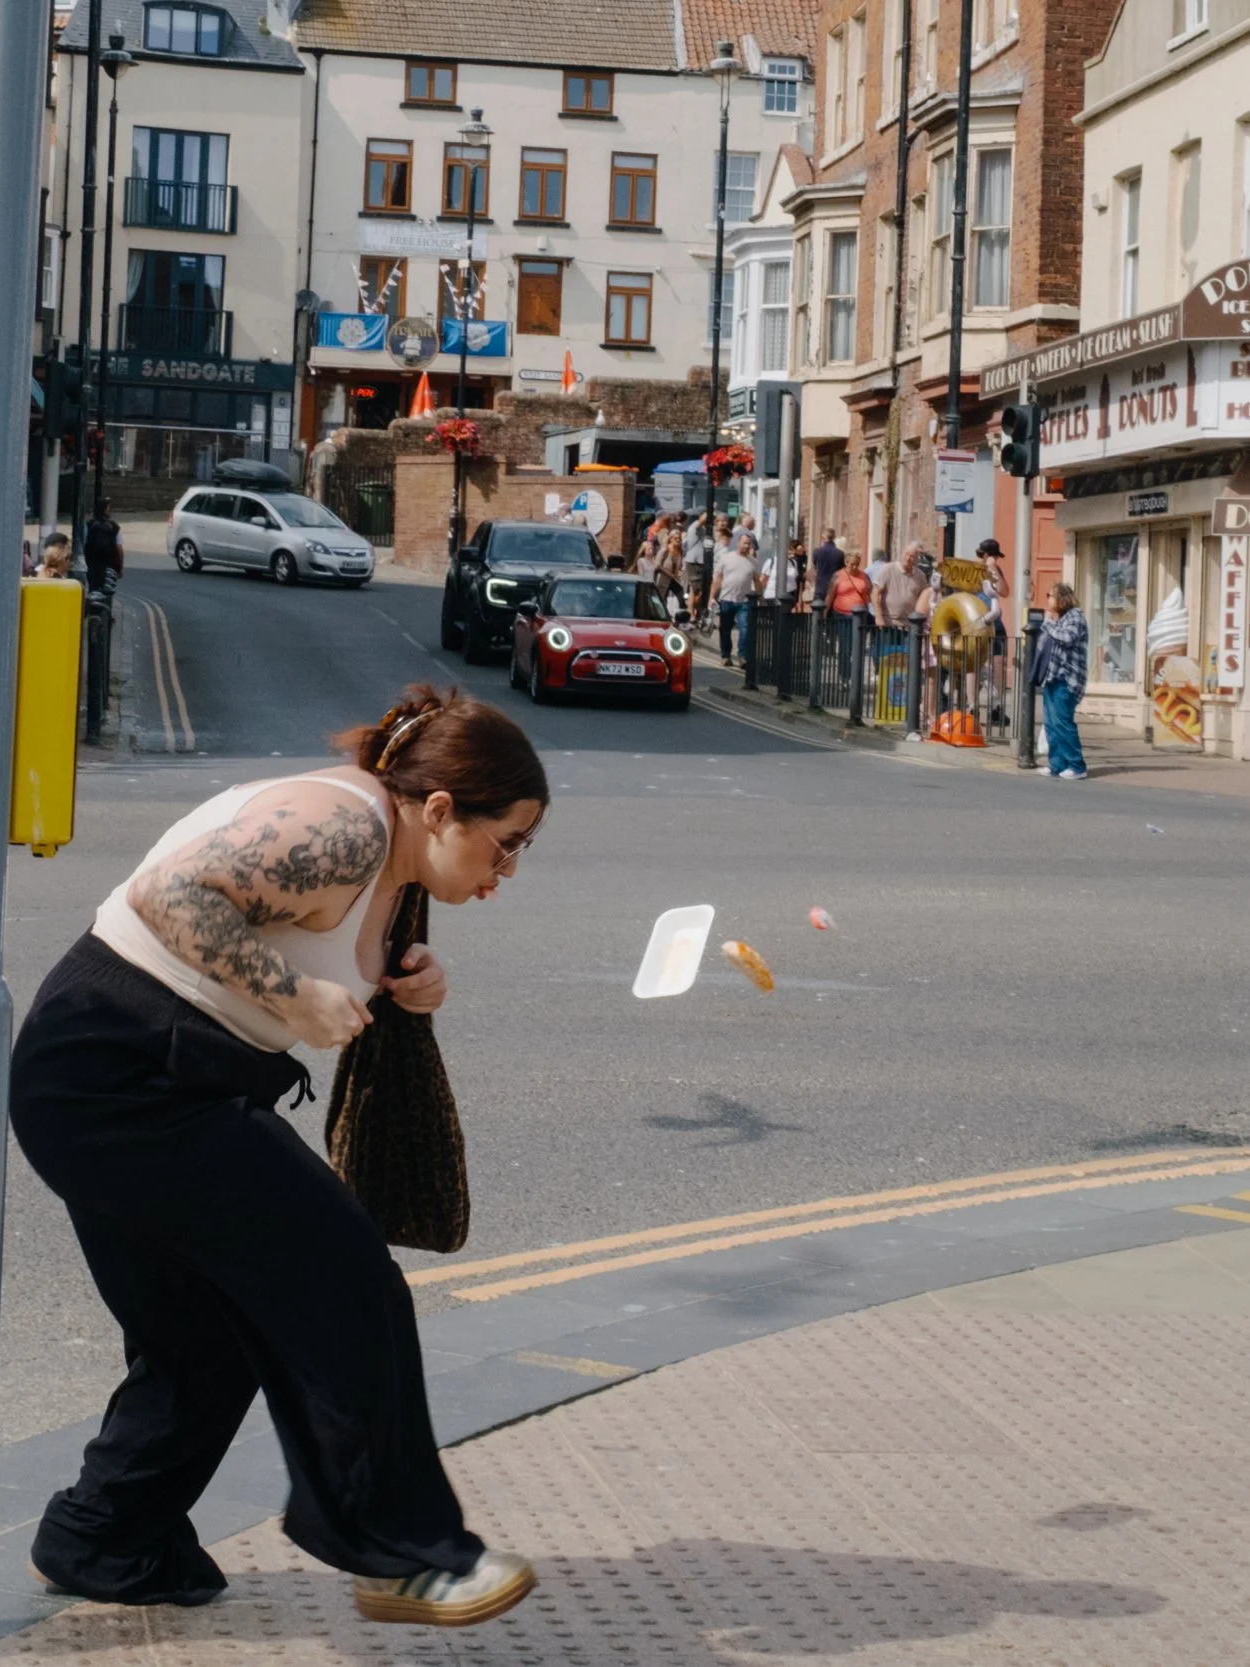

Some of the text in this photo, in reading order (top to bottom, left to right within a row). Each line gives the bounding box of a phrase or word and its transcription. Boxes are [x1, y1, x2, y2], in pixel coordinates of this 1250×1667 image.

[141, 358, 256, 384] SANDGATE
[1036, 344, 1071, 377] SWEETS
[1077, 336, 1094, 363] ICE
[1095, 326, 1131, 358] CREAM
[1039, 382, 1178, 447] AFFLES DONUTS
